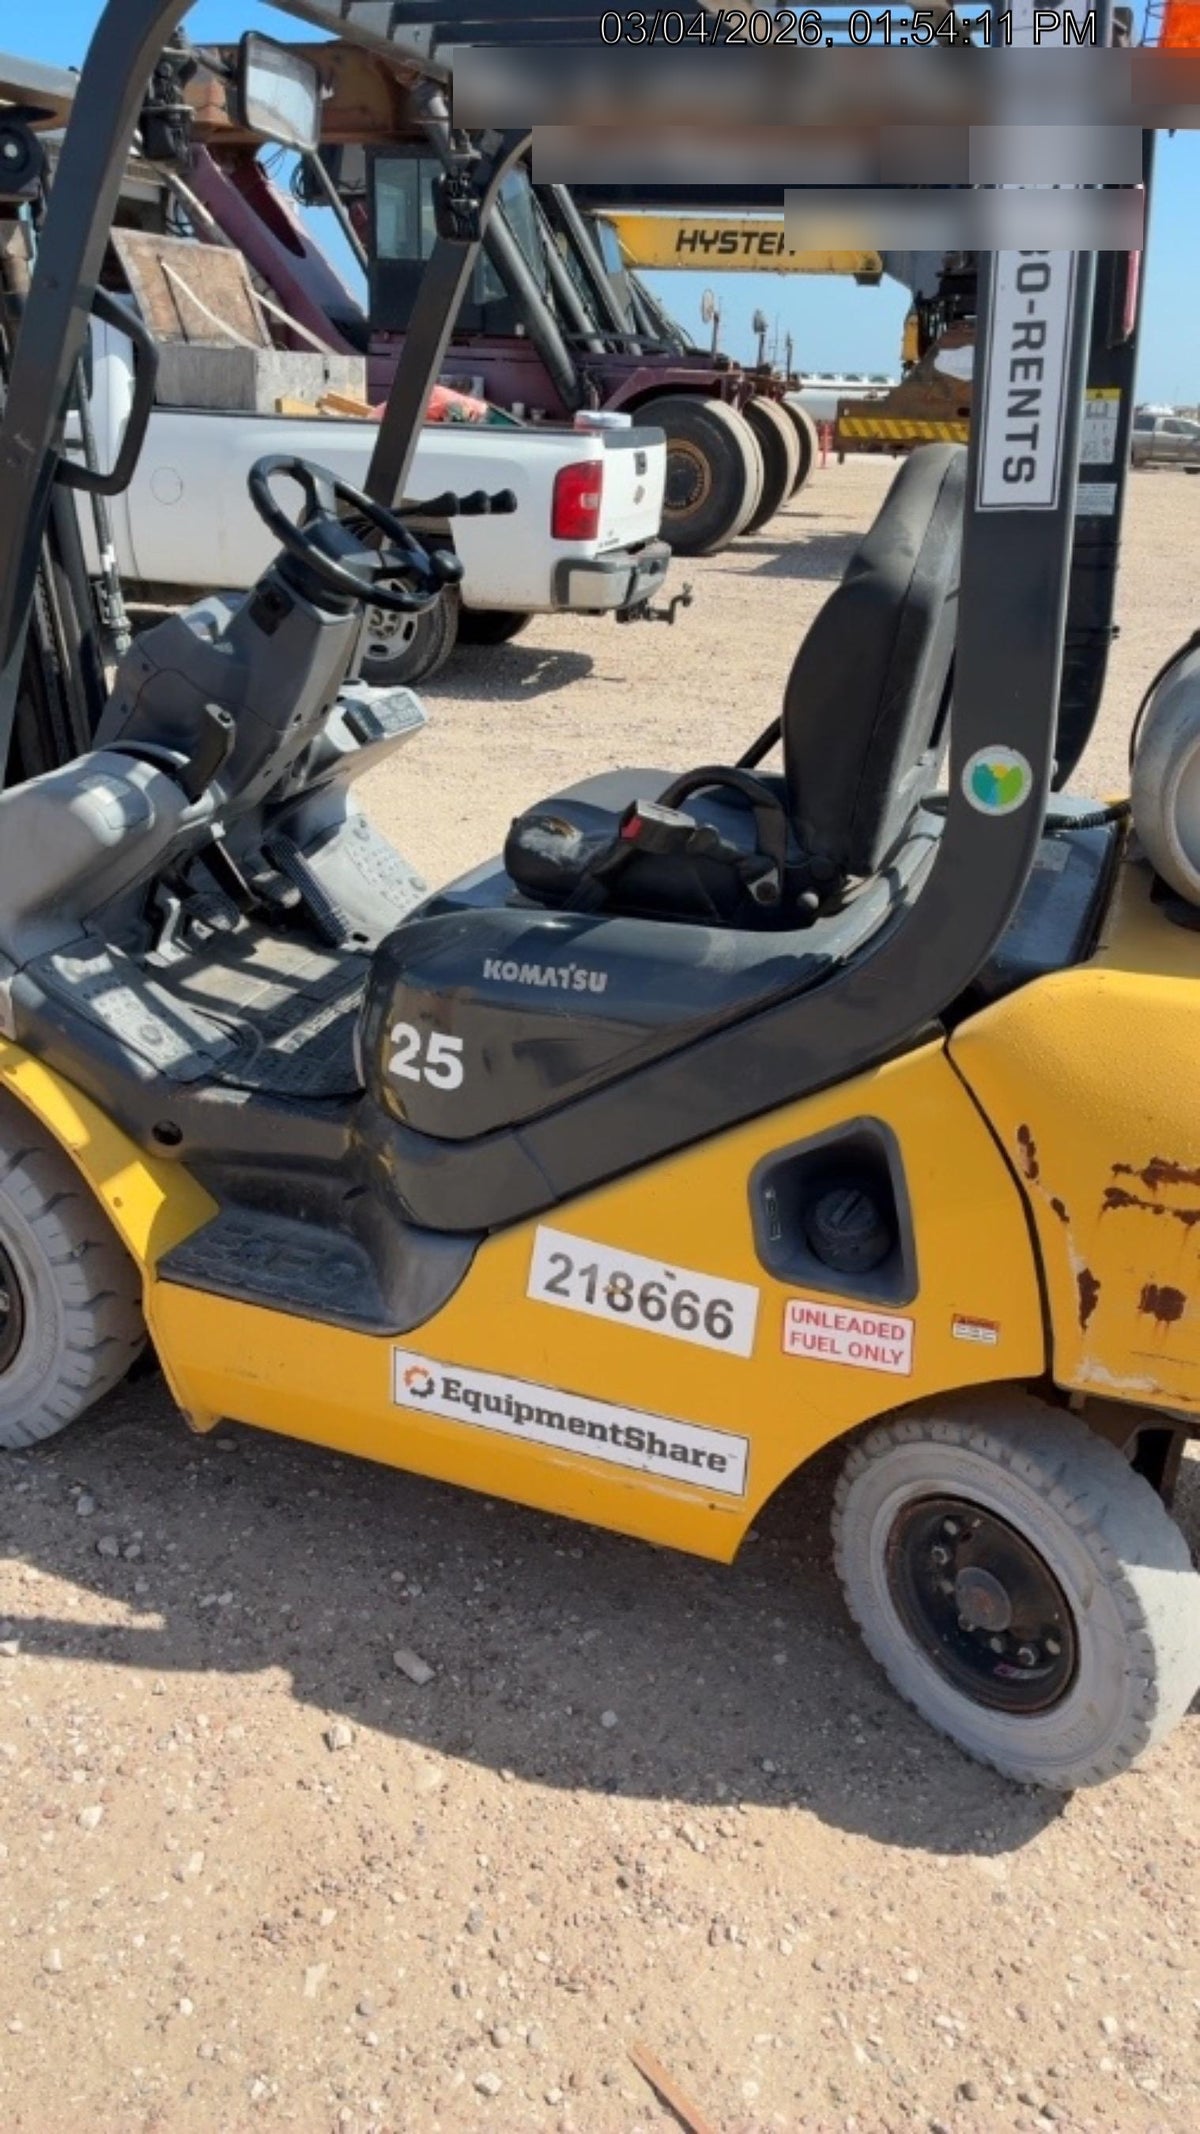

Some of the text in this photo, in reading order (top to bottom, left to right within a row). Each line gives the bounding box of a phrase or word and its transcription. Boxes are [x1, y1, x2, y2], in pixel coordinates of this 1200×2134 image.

[483, 957, 608, 993] KOMATSU
[389, 1021, 463, 1090] 25
[544, 1252, 734, 1339] 218666
[789, 1331, 904, 1365] FUEL ONLY
[791, 1306, 905, 1340] UNLEADED
[441, 1377, 727, 1473] EquipmentShare
